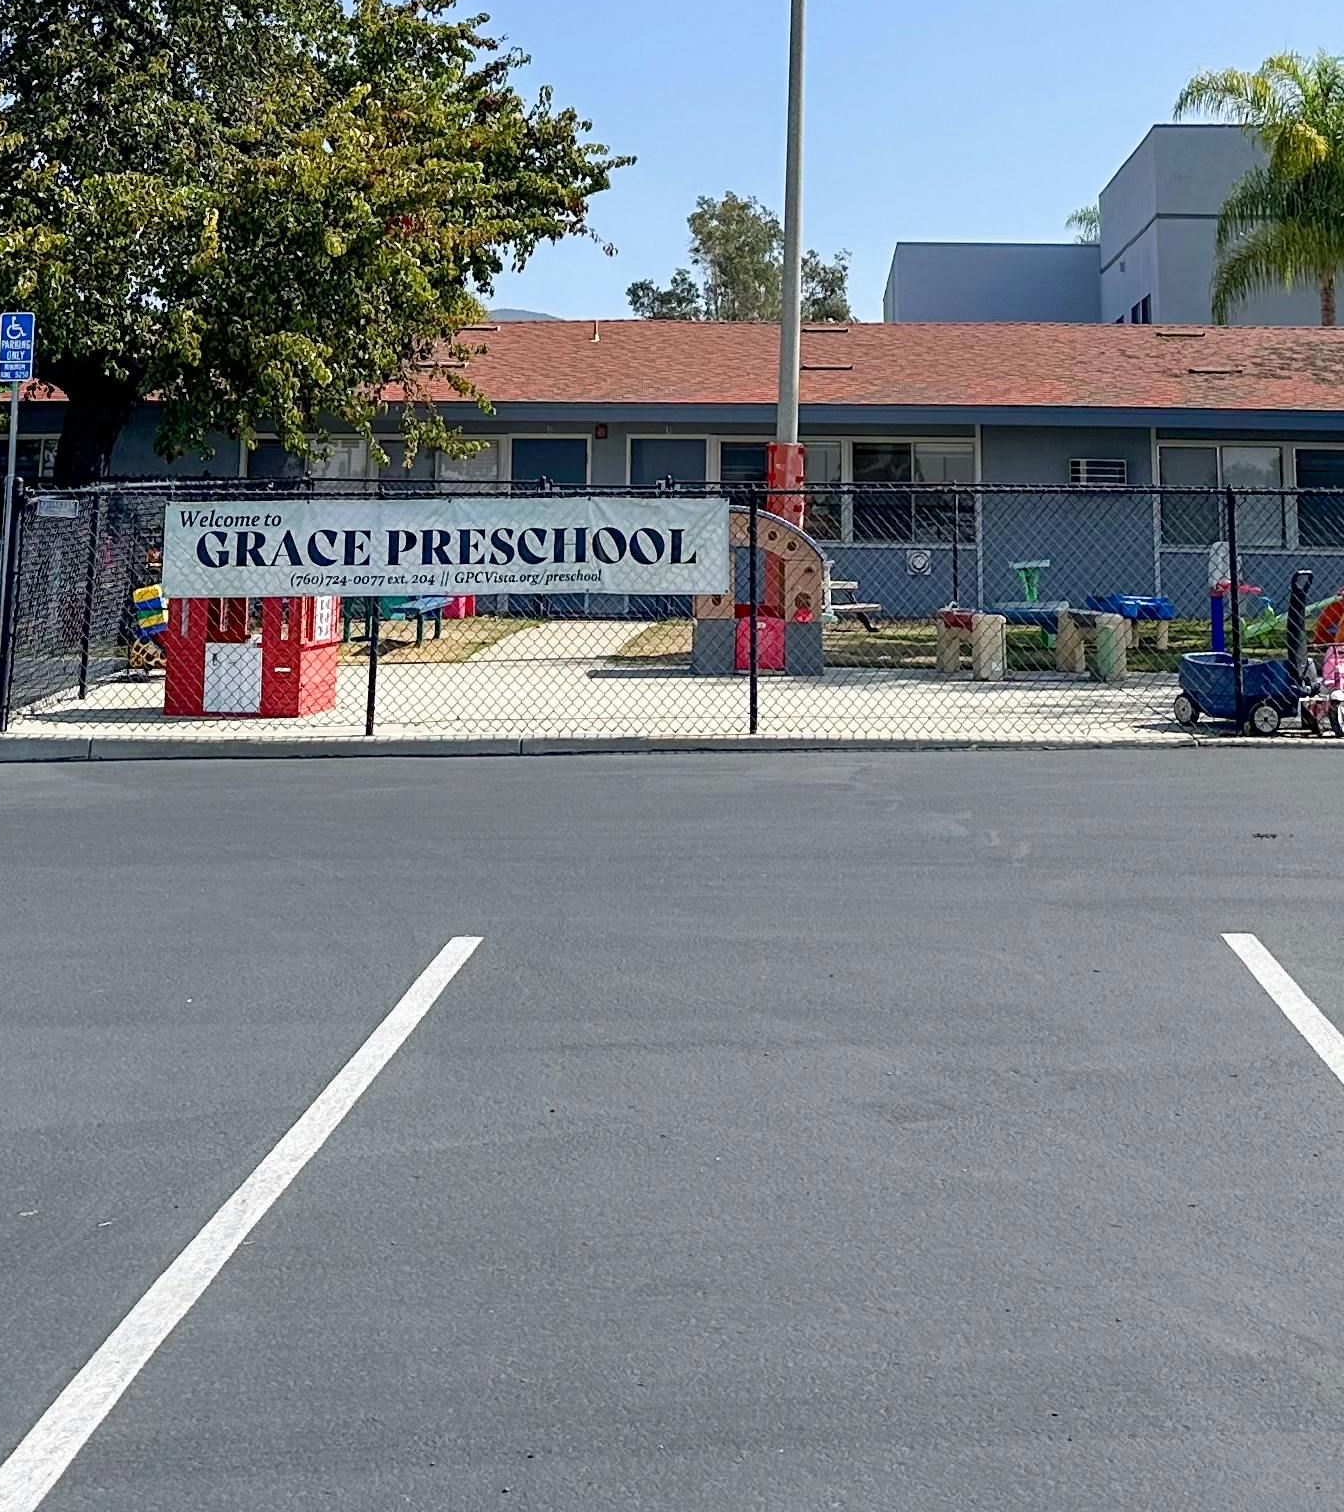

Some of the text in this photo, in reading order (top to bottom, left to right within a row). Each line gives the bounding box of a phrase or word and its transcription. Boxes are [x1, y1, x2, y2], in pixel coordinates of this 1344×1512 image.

[1, 339, 32, 349] PARKING
[6, 350, 25, 360] ONLY
[179, 510, 282, 528] Welcome to
[196, 527, 697, 568] GRACE PRESCHOOL
[387, 574, 408, 585] ext.
[411, 574, 436, 586] 204
[454, 569, 602, 587] GPCVista.org/preschool
